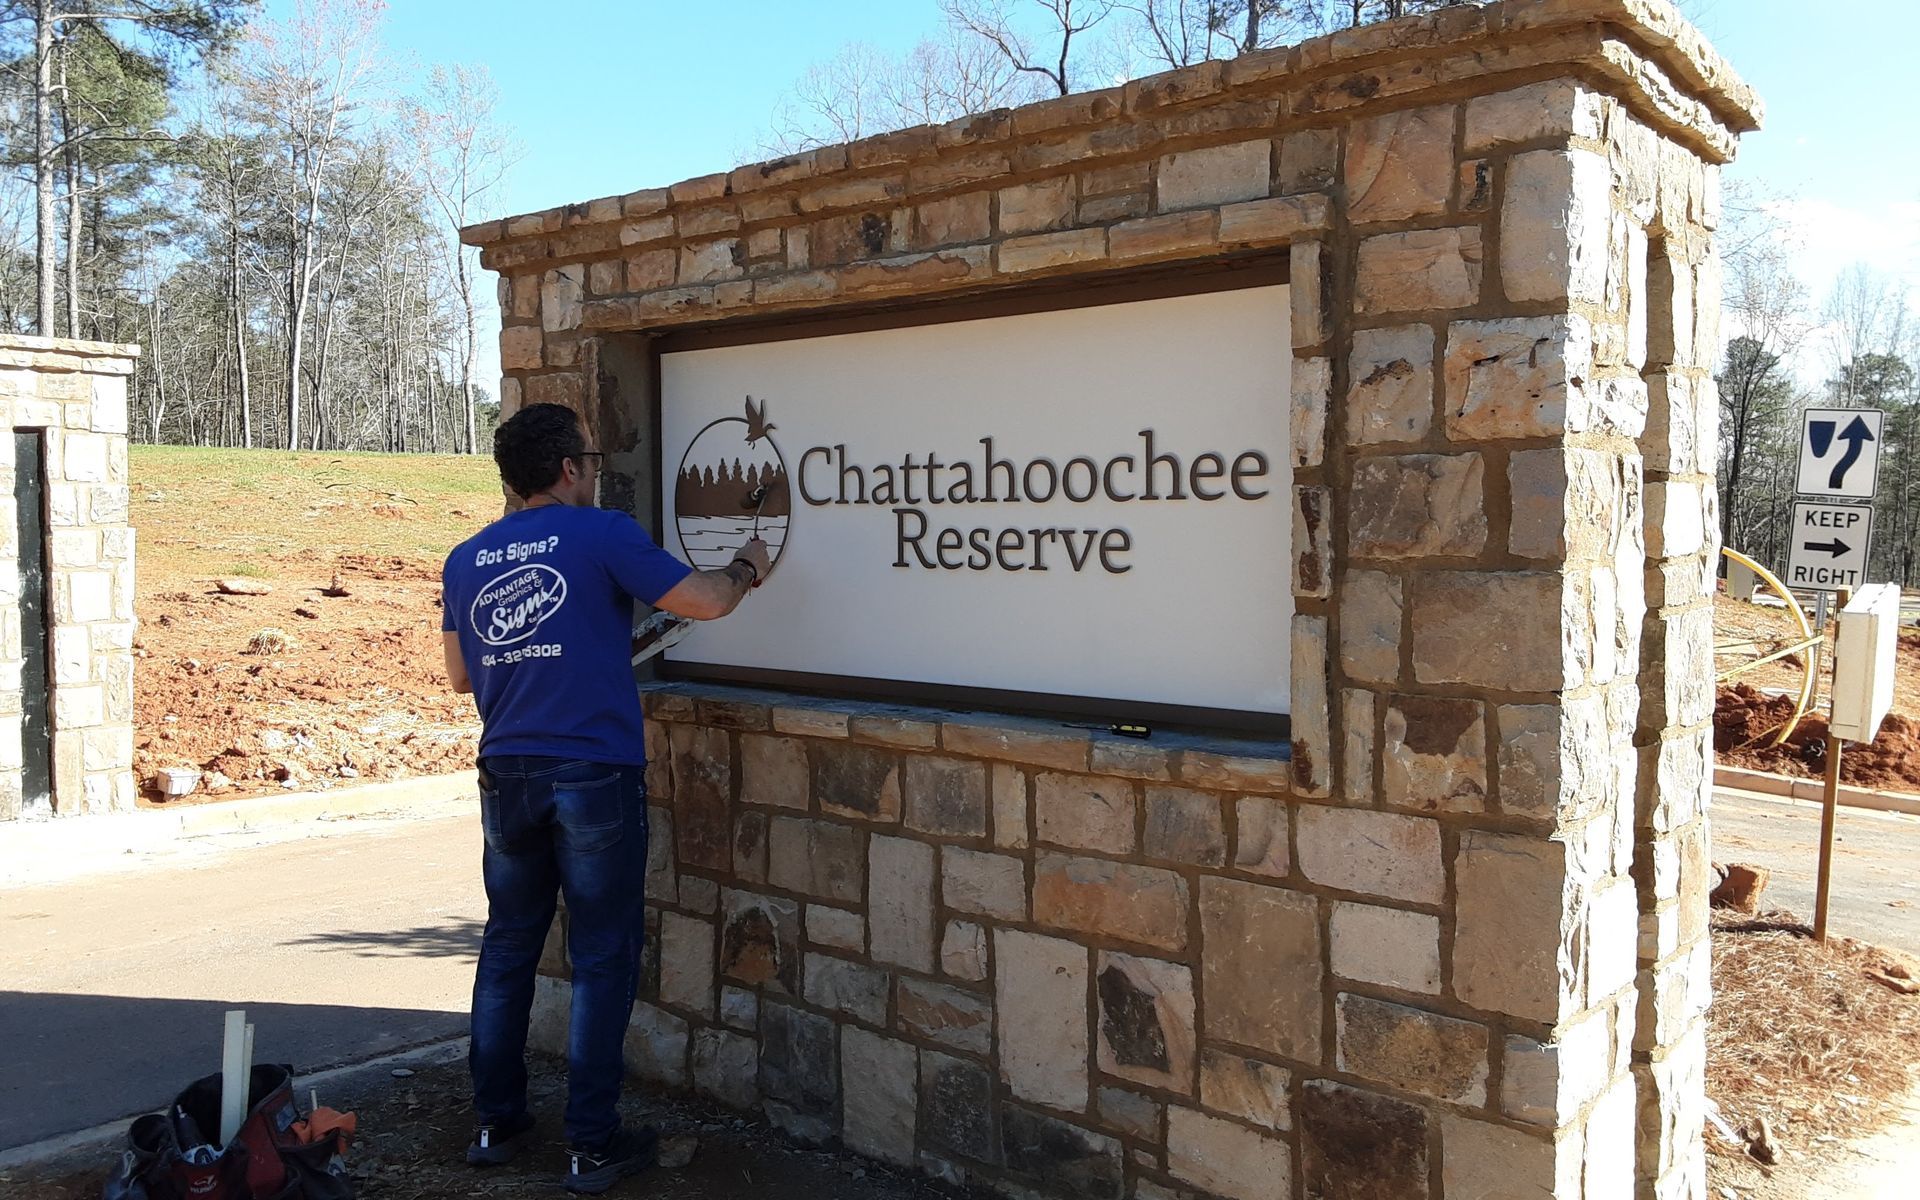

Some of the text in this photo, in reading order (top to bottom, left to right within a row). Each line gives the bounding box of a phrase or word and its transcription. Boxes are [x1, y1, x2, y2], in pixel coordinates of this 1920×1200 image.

[798, 429, 1269, 505] Chattahoochee
[1805, 510, 1860, 528] KEEP
[476, 536, 559, 567] Got Signs?
[892, 507, 1132, 573] Reserve
[479, 569, 539, 608] ADVANTAGE
[498, 578, 542, 606] Graphics &
[1794, 566, 1858, 585] RIGHT
[488, 587, 549, 641] Signs
